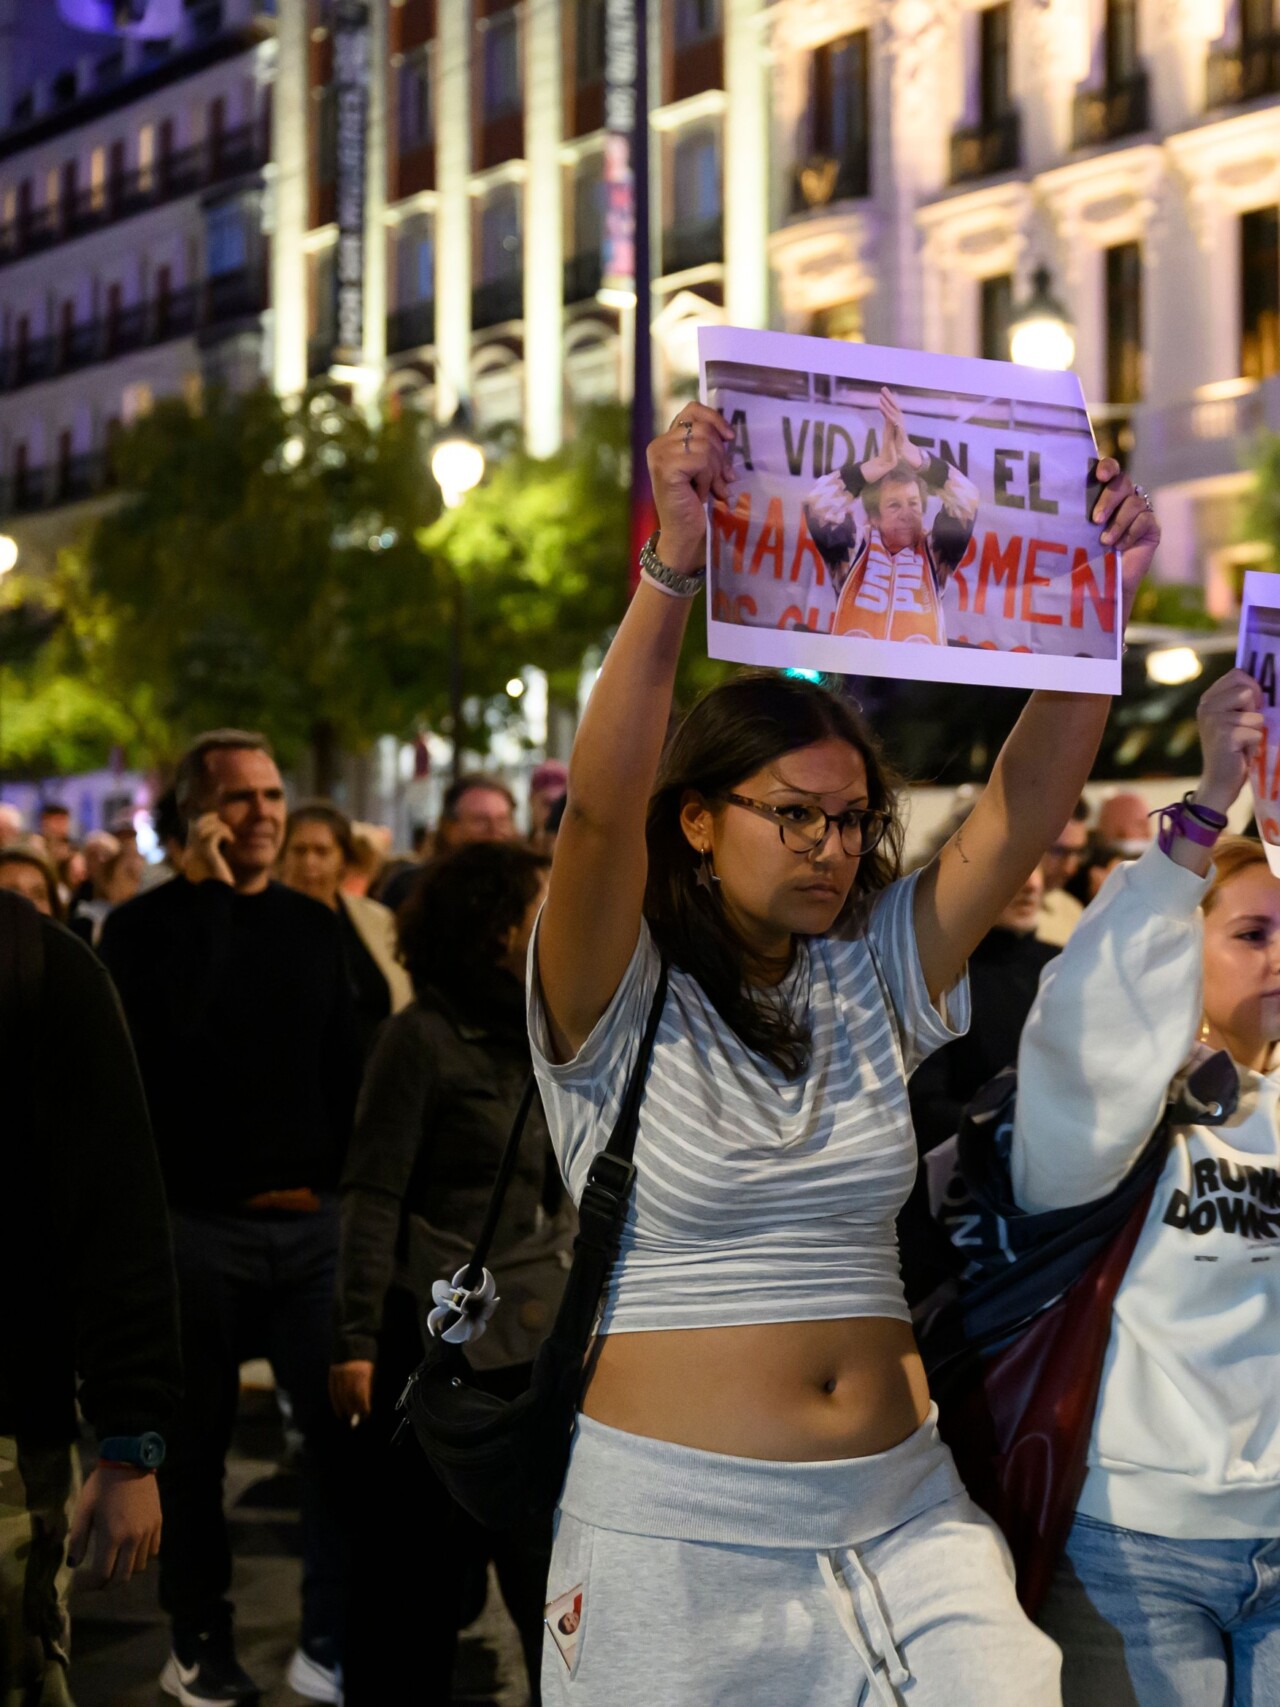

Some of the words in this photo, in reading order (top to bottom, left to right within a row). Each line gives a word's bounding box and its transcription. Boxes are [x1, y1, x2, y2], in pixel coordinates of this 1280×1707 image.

[717, 408, 754, 471] A
[994, 449, 1058, 515] EL
[1248, 652, 1276, 707] A
